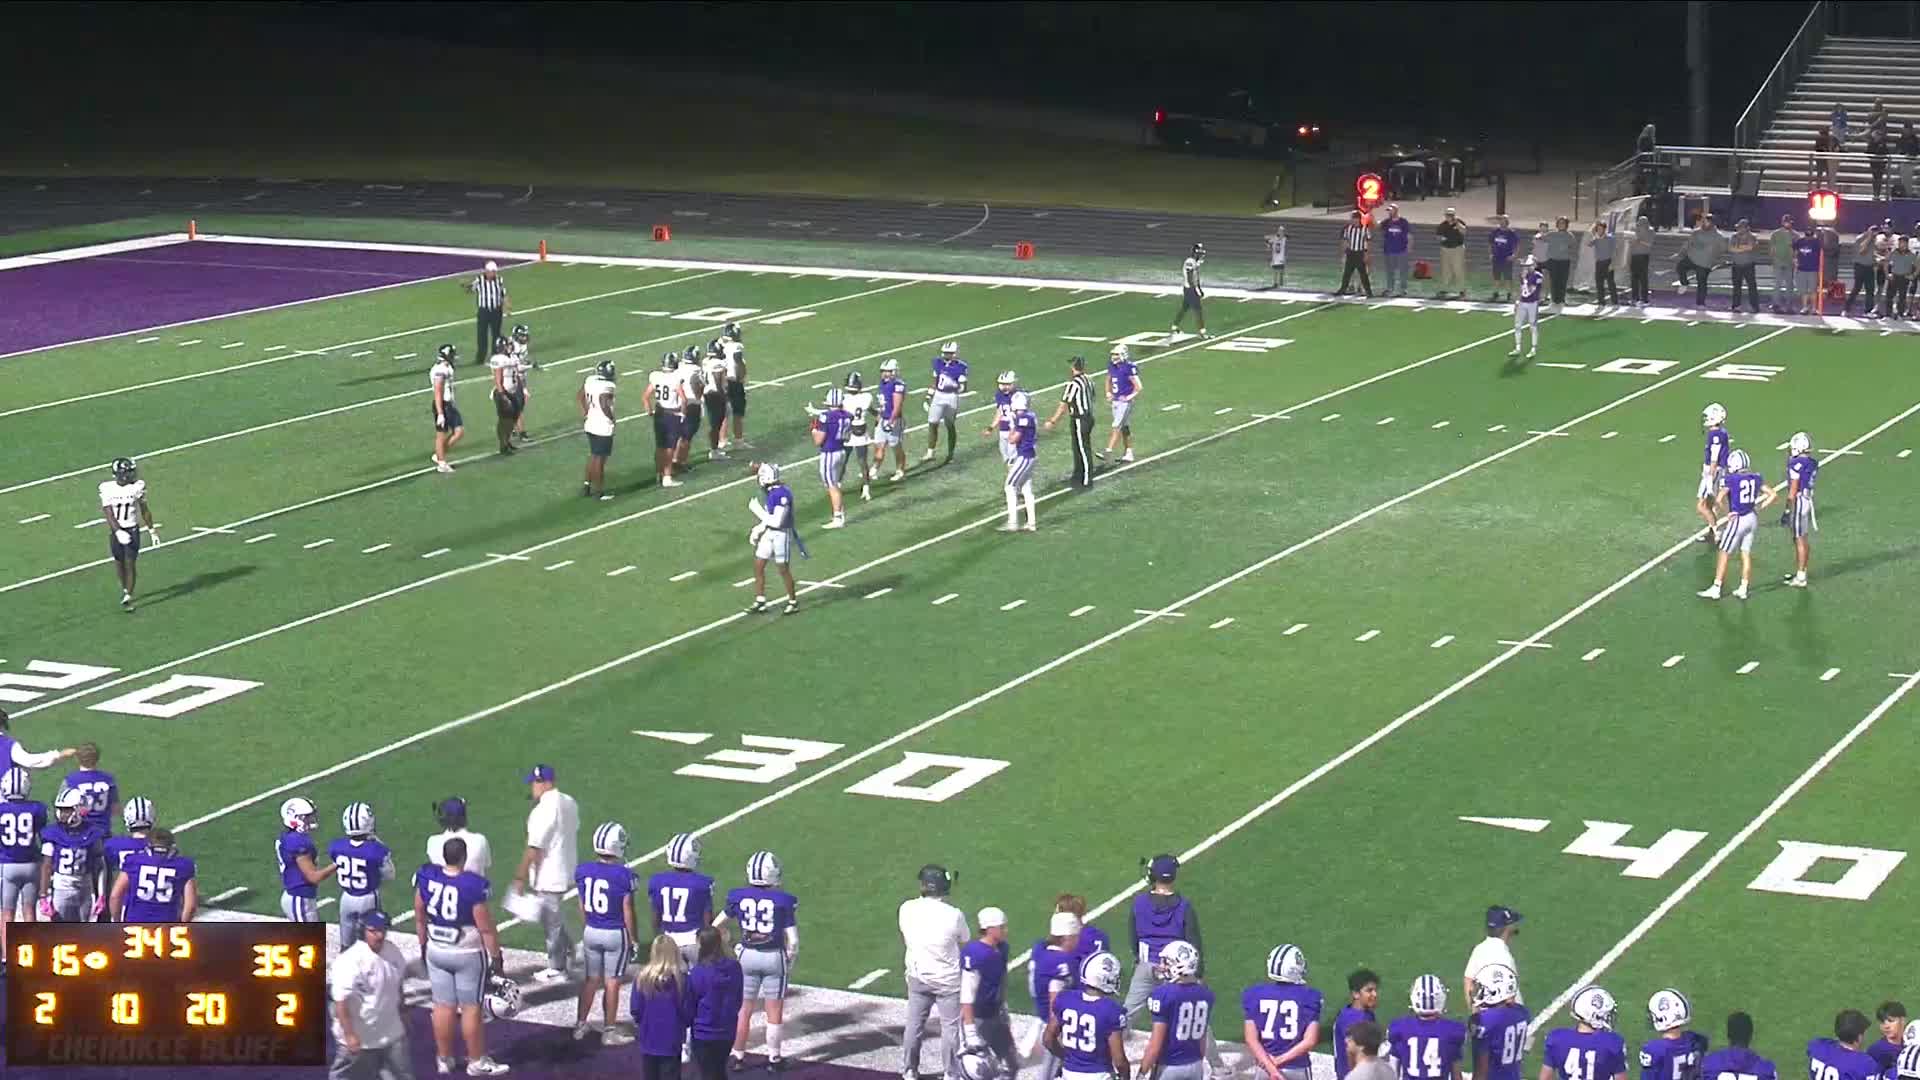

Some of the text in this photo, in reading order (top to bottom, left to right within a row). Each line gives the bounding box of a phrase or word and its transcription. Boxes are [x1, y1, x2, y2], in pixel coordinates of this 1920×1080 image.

[1363, 179, 1380, 200] 2
[655, 384, 669, 401] 58
[1740, 480, 1755, 504] 21
[116, 503, 131, 520] 11
[1, 812, 33, 846] 39
[137, 865, 176, 903] 55
[336, 855, 368, 889] 25
[424, 880, 459, 921] 78
[584, 877, 609, 914] 16
[660, 887, 689, 923] 17
[739, 898, 775, 934] 33
[17, 944, 34, 967] 0
[53, 944, 80, 976] 15
[252, 944, 293, 977] 35
[298, 945, 316, 969] 2
[35, 992, 56, 1025] 2
[112, 992, 139, 1025] 10
[186, 992, 227, 1026] 20
[276, 993, 297, 1026] 2
[1176, 1001, 1209, 1041] 88
[1259, 1000, 1299, 1040] 73
[1062, 1008, 1097, 1052] 23
[1504, 1021, 1528, 1065] 87
[1407, 1037, 1442, 1077] 14
[1564, 1047, 1596, 1080] 41
